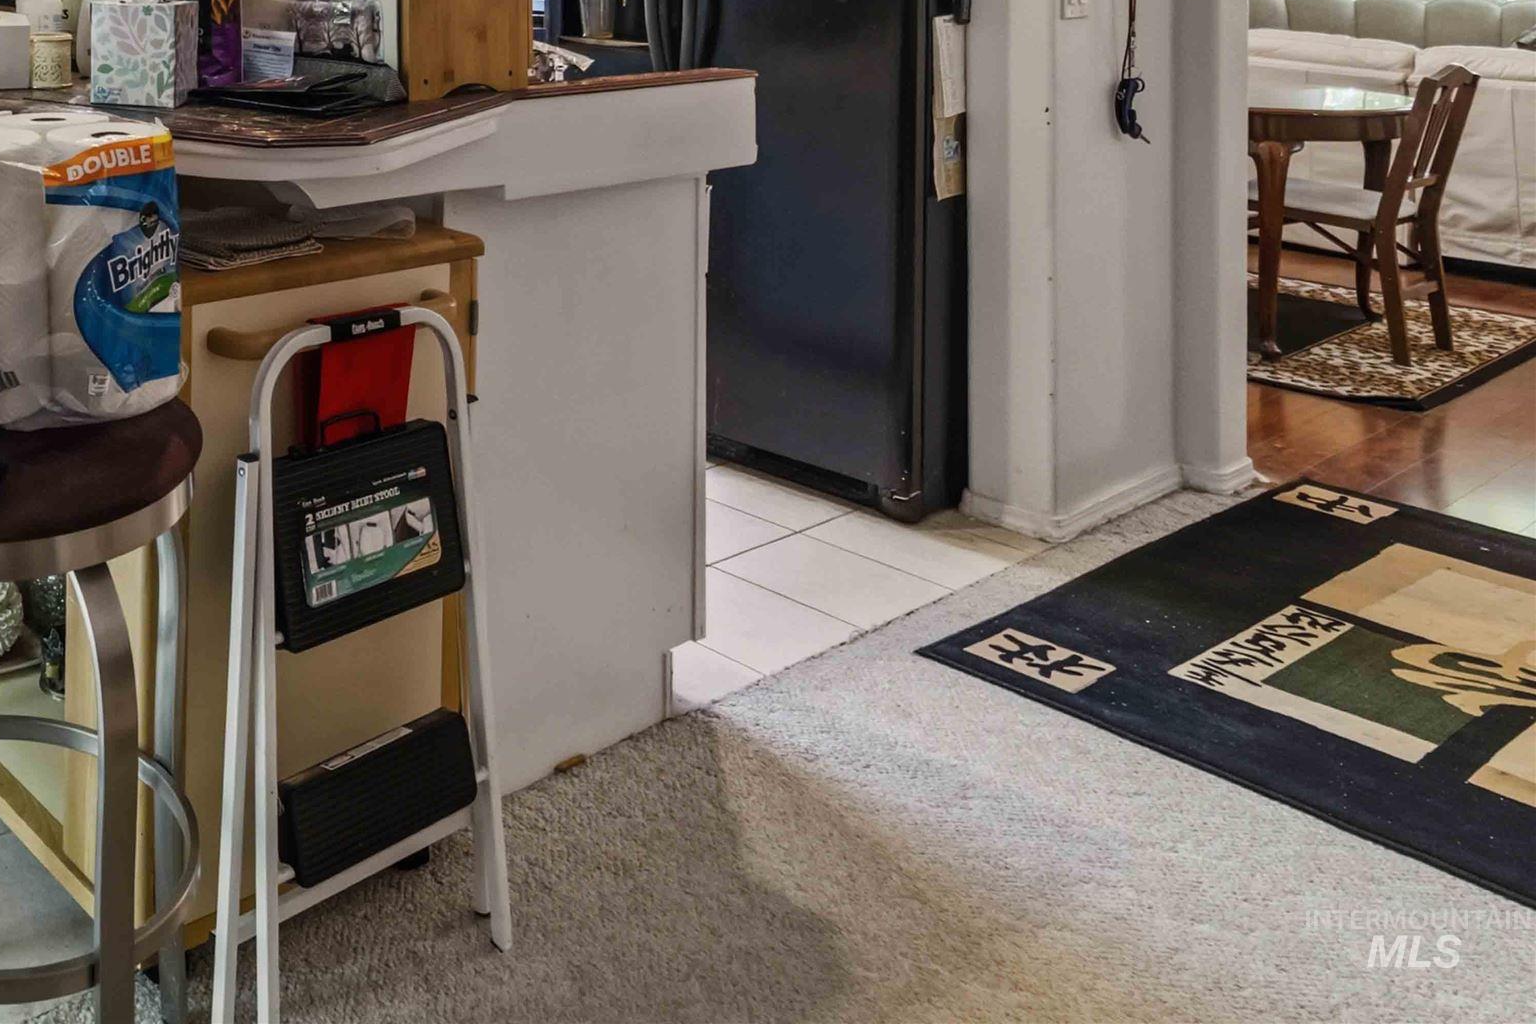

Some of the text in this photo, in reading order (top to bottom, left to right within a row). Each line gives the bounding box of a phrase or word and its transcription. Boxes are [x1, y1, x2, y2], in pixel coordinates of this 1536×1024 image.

[66, 143, 153, 182] DOUBLE
[305, 514, 315, 526] 2
[315, 502, 351, 520] SKINNY
[374, 486, 401, 502] STOOL
